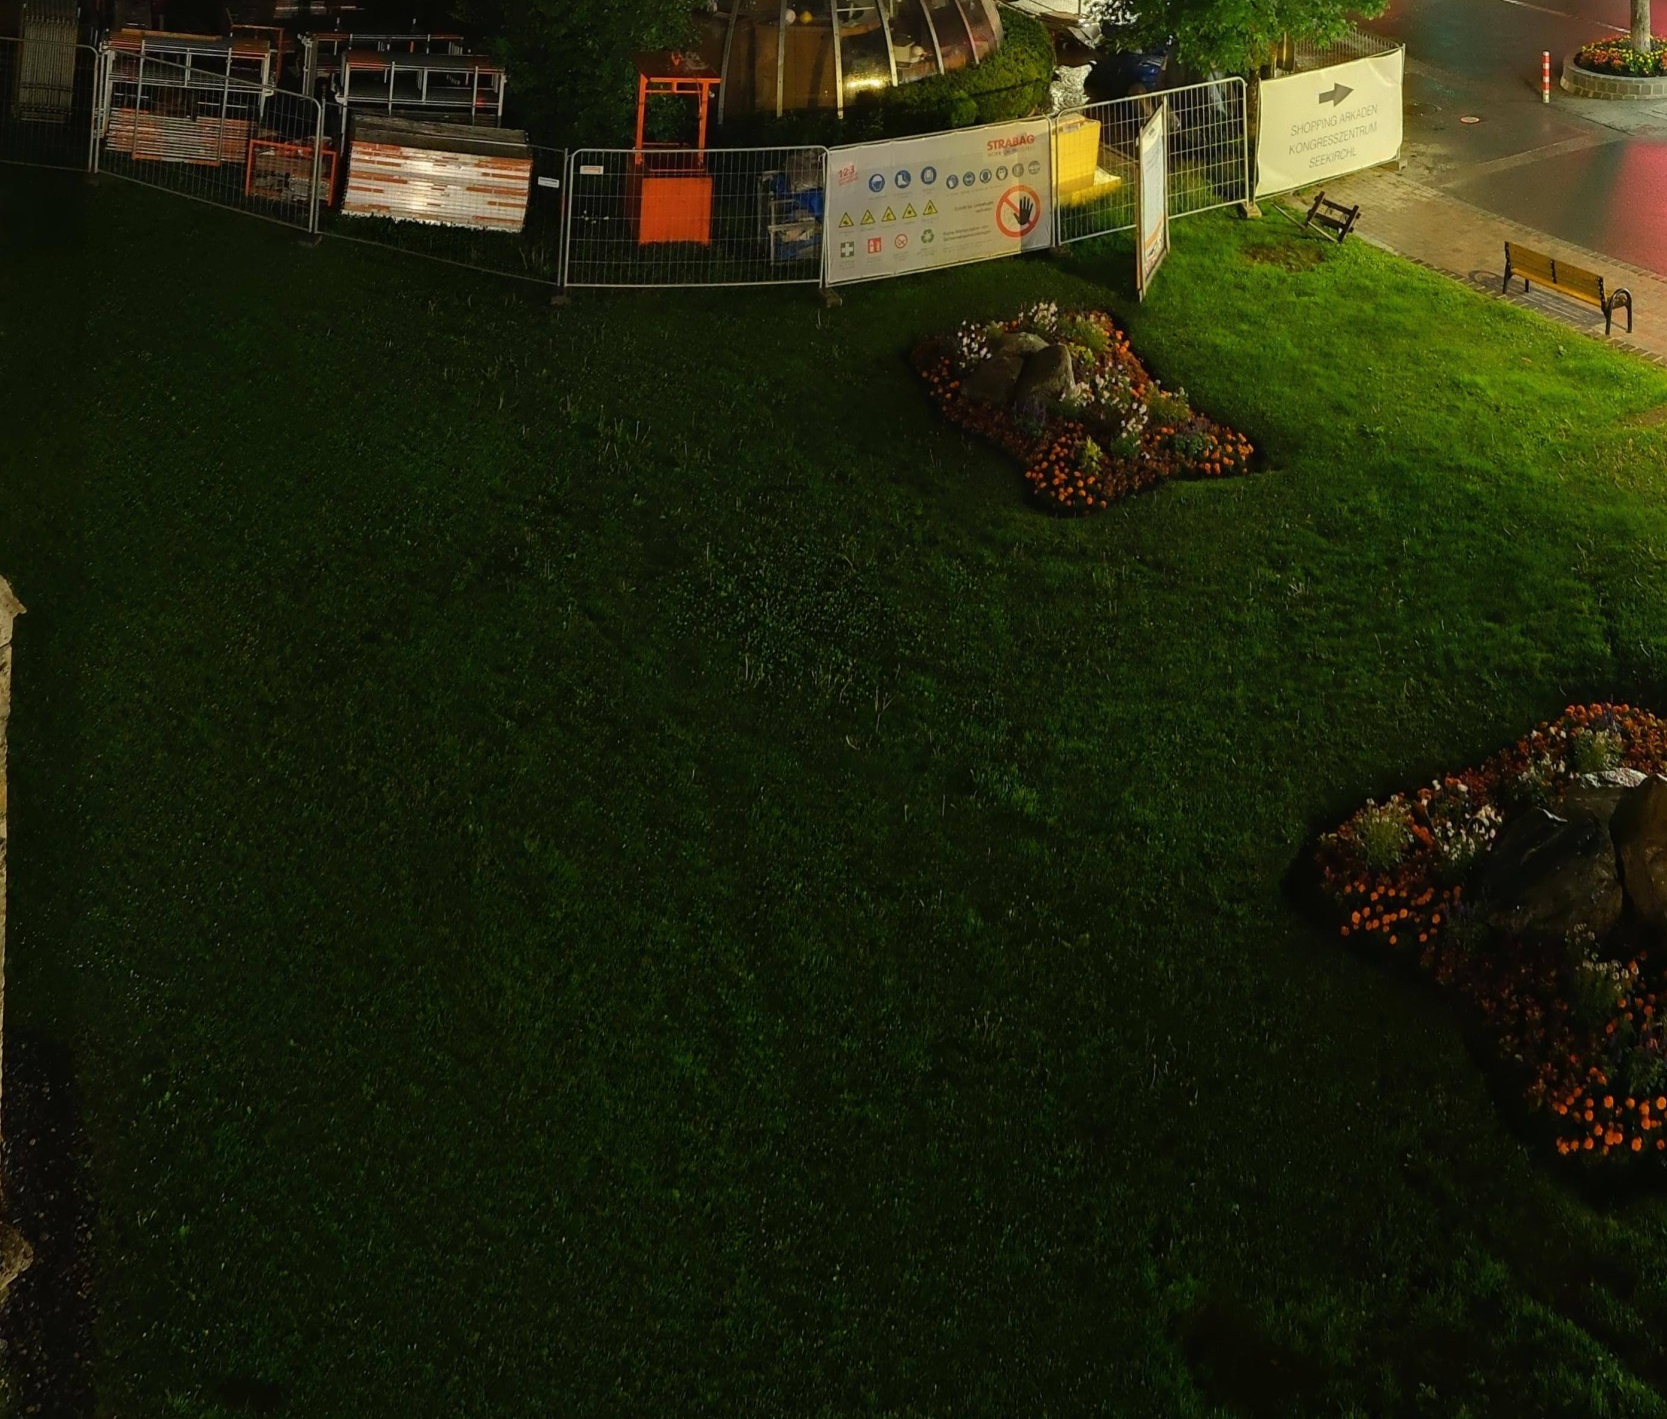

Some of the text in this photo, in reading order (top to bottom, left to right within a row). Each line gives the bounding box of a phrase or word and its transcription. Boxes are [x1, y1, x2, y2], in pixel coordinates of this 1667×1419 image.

[1290, 104, 1378, 137] SHOPPING ARKADEN
[987, 134, 1035, 151] STRABAG
[1289, 121, 1378, 155] KONGRESSZENTRUM
[1309, 147, 1357, 168] SEEKIRCHL
